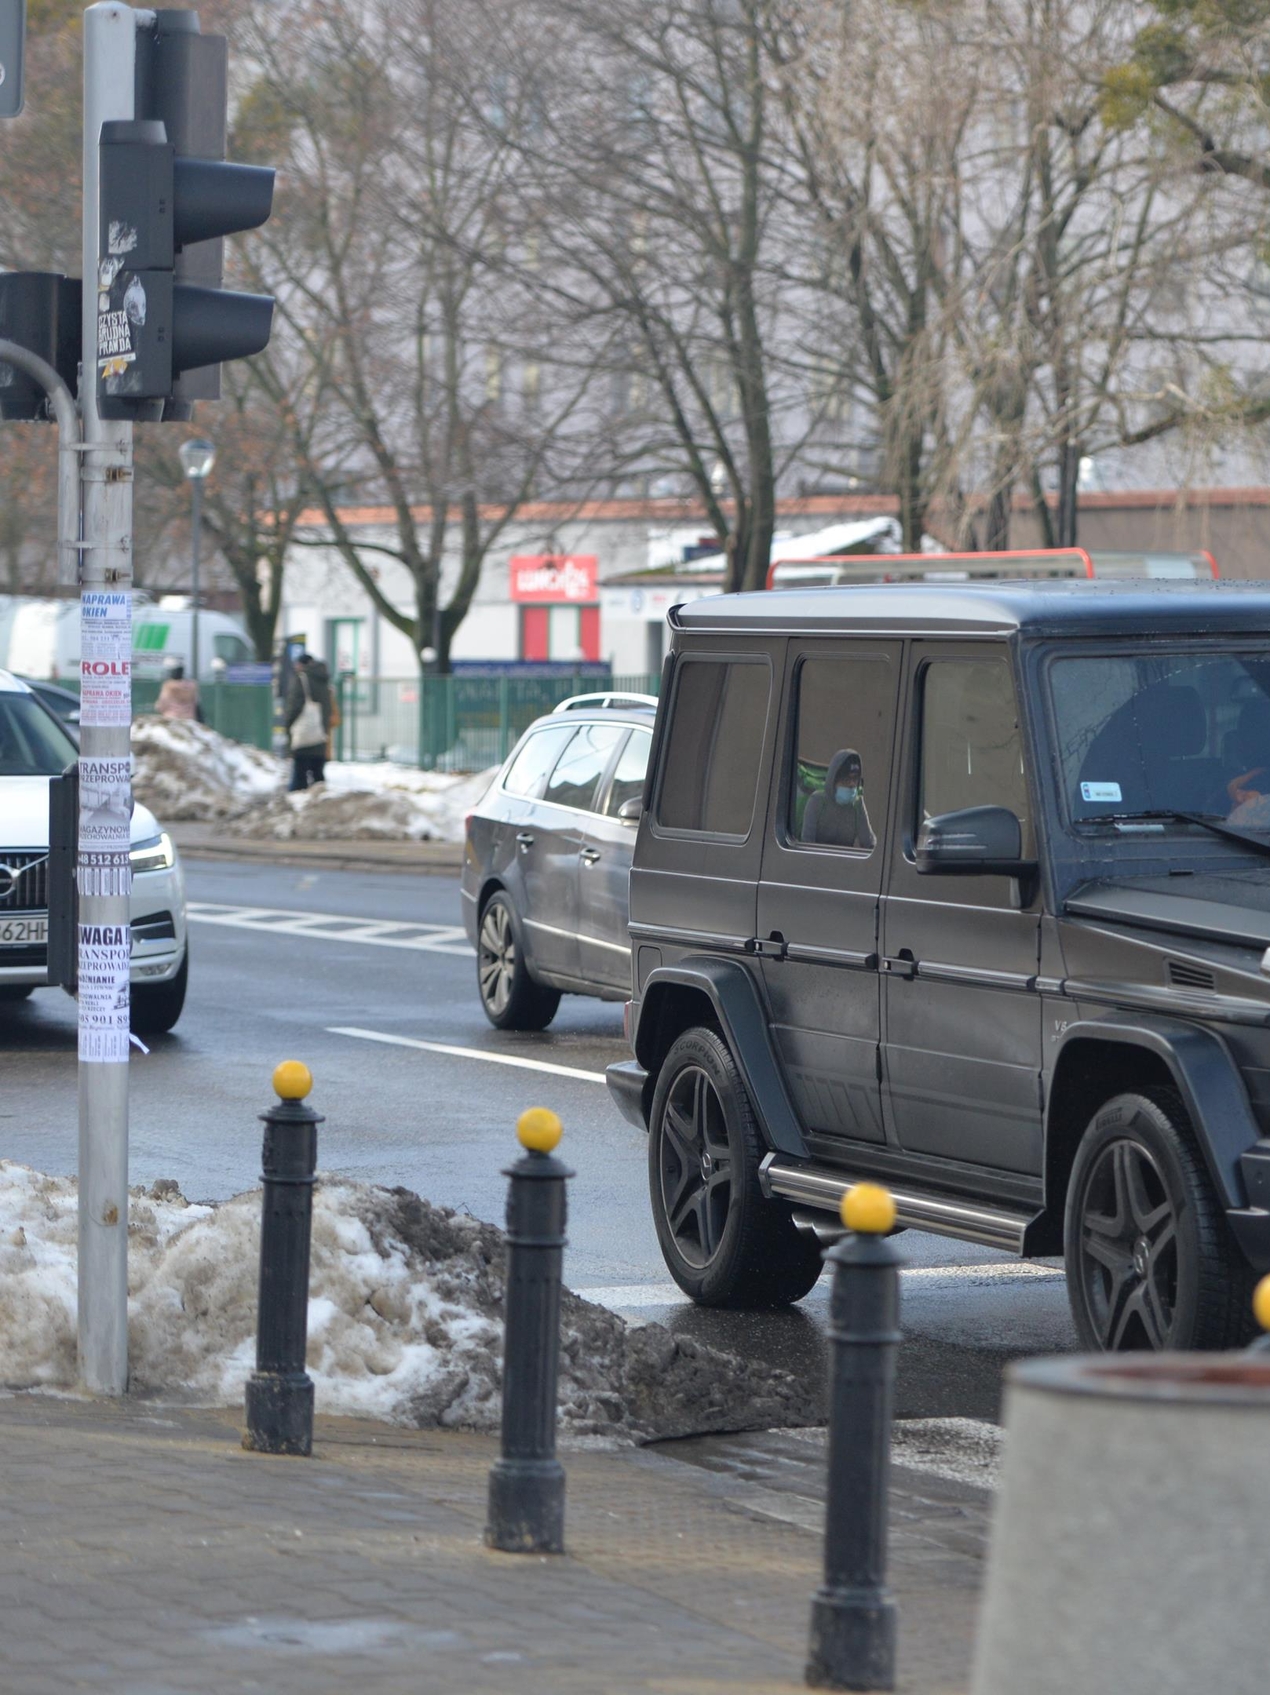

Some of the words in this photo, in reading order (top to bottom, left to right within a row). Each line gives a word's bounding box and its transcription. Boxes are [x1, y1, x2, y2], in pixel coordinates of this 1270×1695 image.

[90, 854, 111, 865] 512
[0, 922, 49, 942] 62HH
[80, 926, 123, 946] WAGA
[92, 1015, 112, 1024] 901
